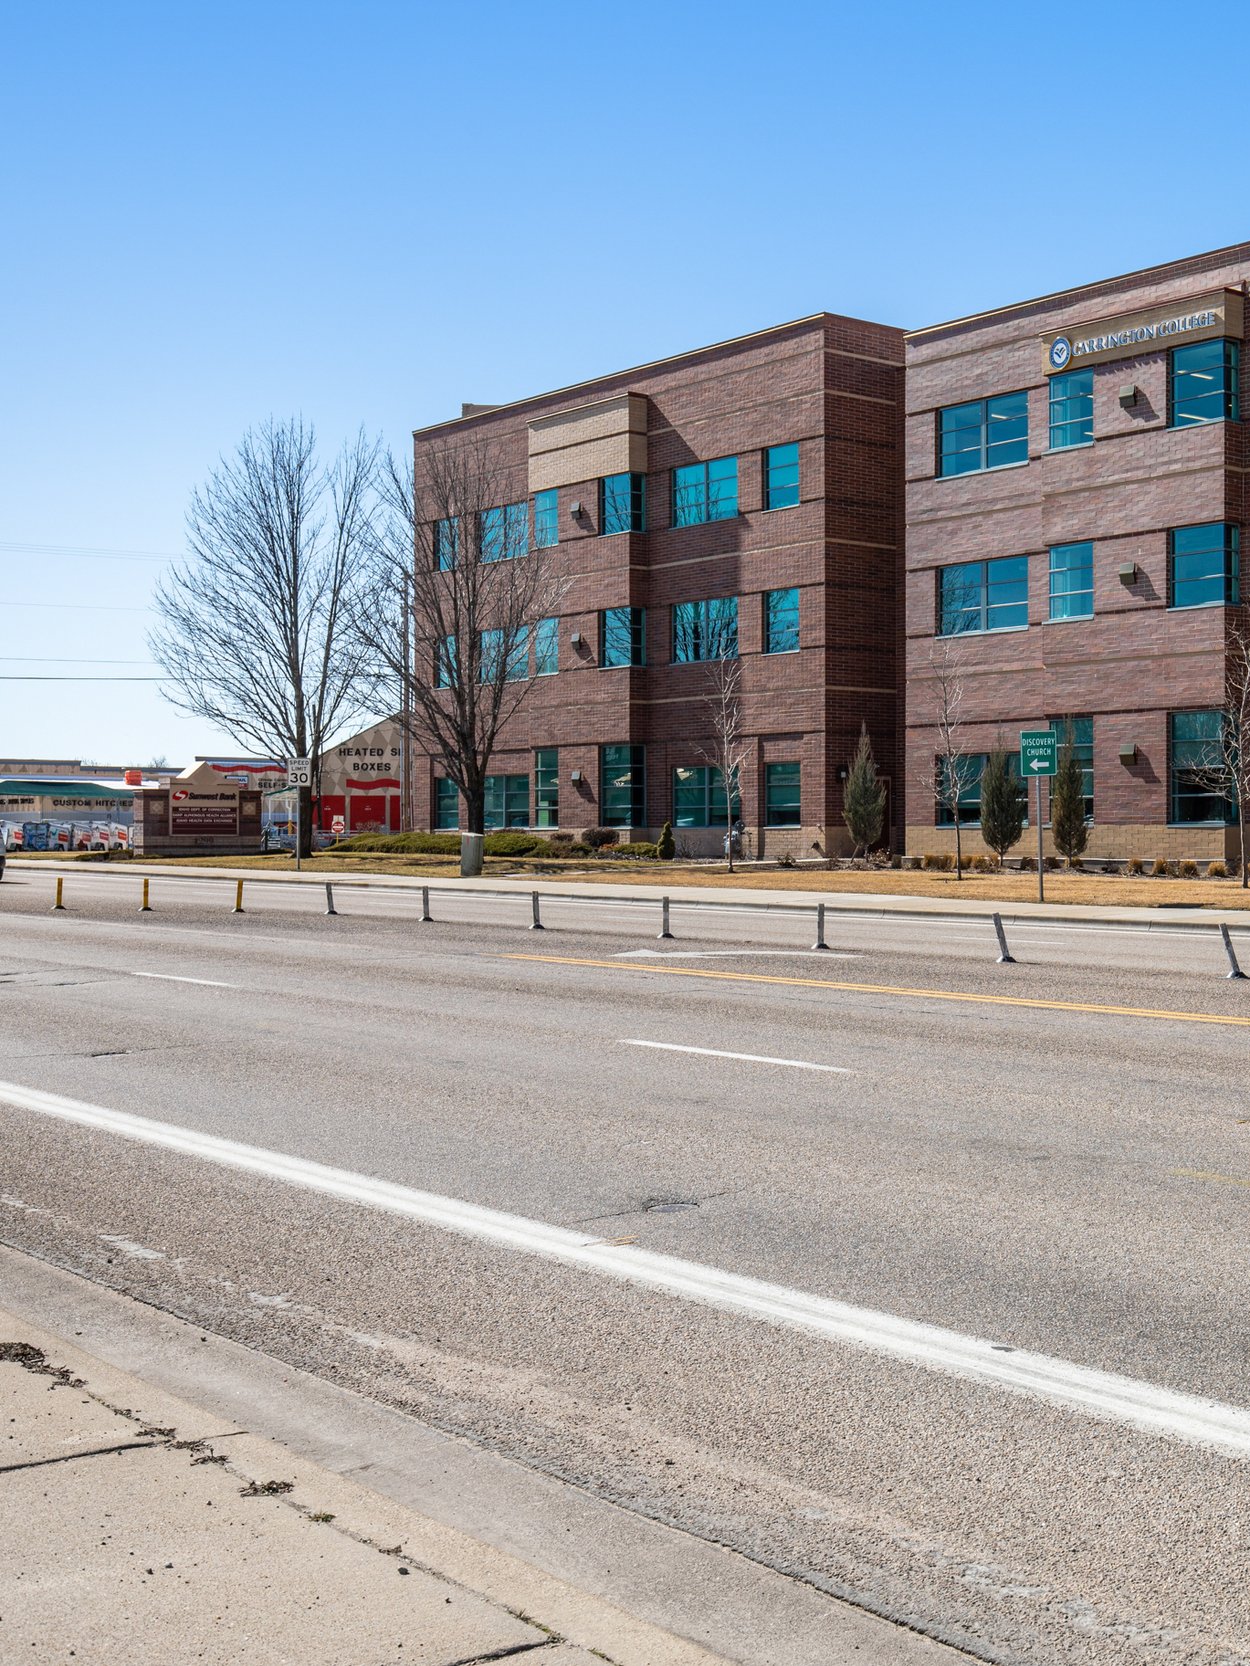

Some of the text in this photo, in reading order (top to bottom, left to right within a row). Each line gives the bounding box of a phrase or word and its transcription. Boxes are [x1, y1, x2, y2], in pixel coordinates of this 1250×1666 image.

[1072, 311, 1216, 357] CARRINGTON COLLEGE
[1022, 738, 1055, 746] DISCOVERY
[339, 747, 384, 756] HEATED
[1026, 748, 1052, 756] CHURCH
[353, 762, 391, 771] BOXES
[290, 772, 308, 783] 30
[189, 792, 236, 800] Sunwest Bank
[53, 799, 92, 807] CUSTOM
